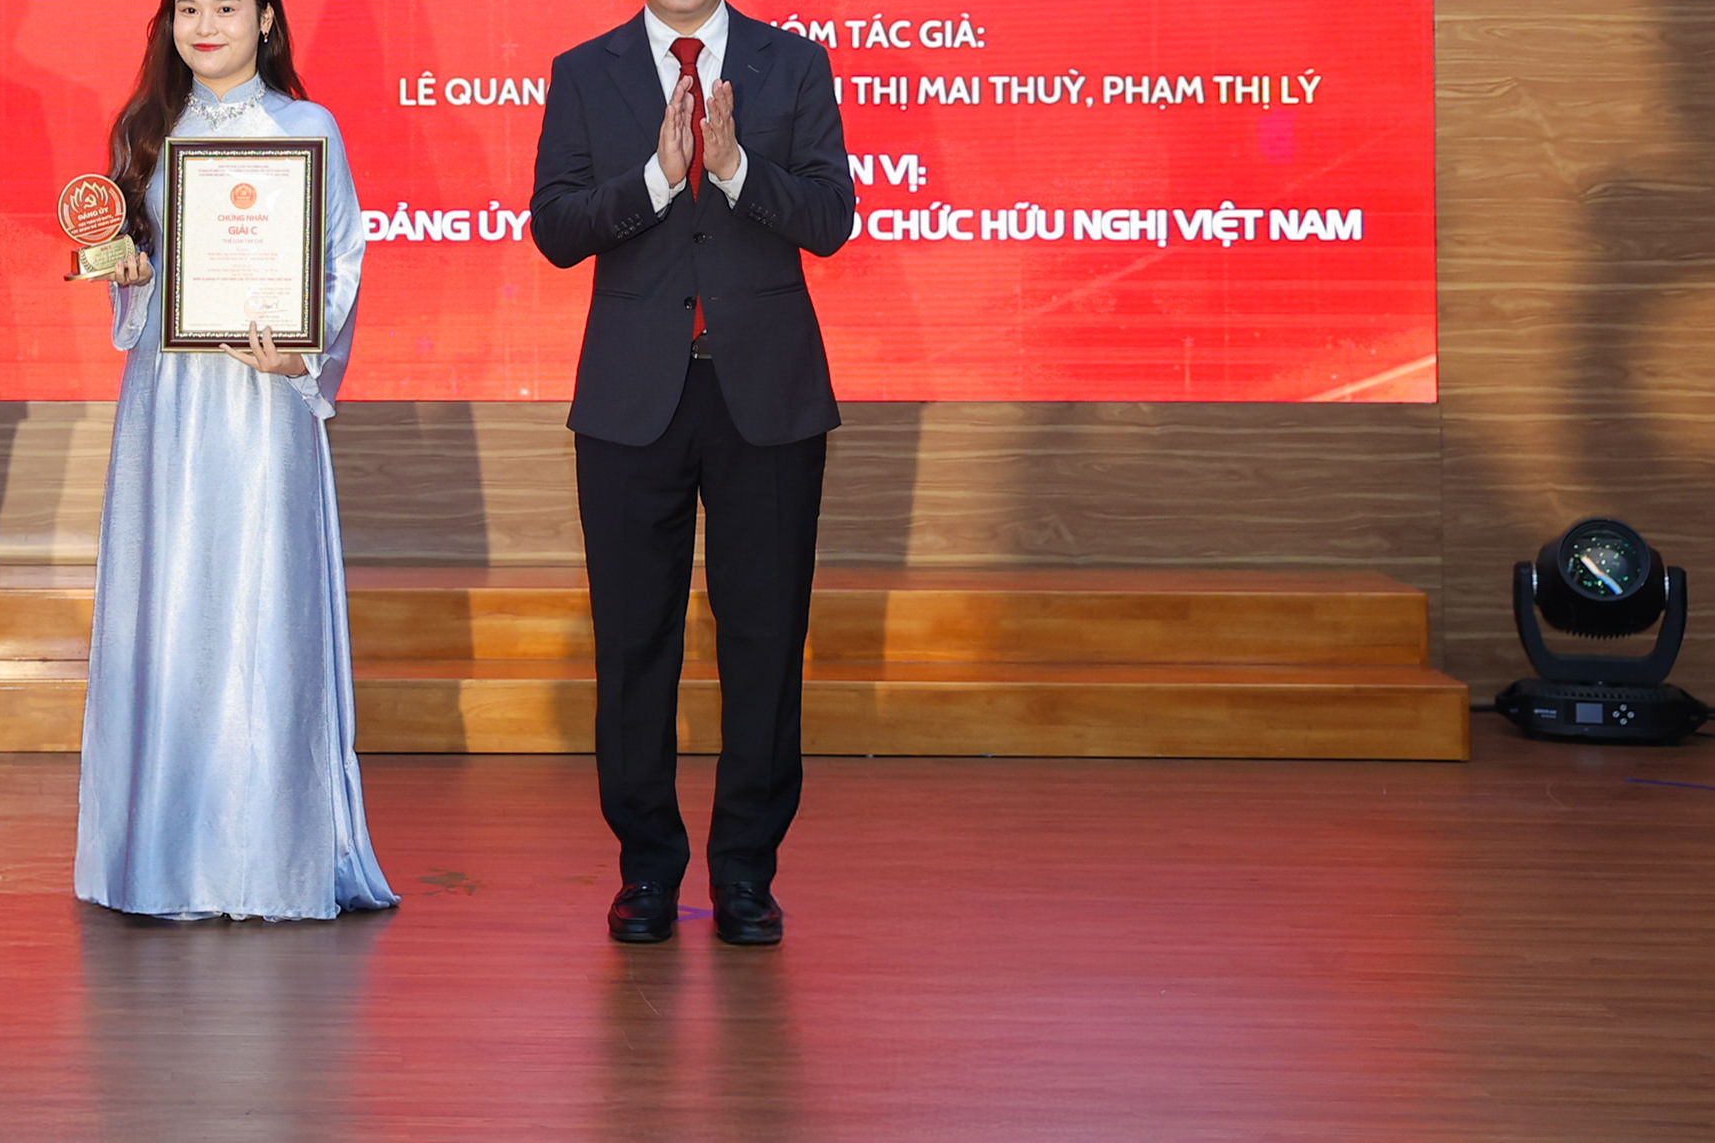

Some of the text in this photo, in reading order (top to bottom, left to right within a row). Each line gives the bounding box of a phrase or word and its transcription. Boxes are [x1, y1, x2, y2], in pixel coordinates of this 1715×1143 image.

[844, 13, 912, 49] TÁC
[918, 12, 986, 48] GIẢ:
[399, 70, 549, 106] LÊ QUAN
[850, 76, 908, 111] THỊ
[917, 76, 980, 105] MAI
[988, 68, 1094, 109] THUỲ,
[1103, 75, 1204, 110] PHẠM
[1212, 75, 1270, 110] THỊ
[1281, 68, 1322, 104] LÝ
[878, 154, 927, 193] VỊ:
[361, 200, 532, 242] ĐẢNG ỦY
[867, 201, 974, 242] CHỨC
[980, 201, 1065, 242] HỮU
[1073, 209, 1168, 248] NGHỊ
[1172, 200, 1264, 248] VIỆT
[1269, 209, 1362, 241] NAM
